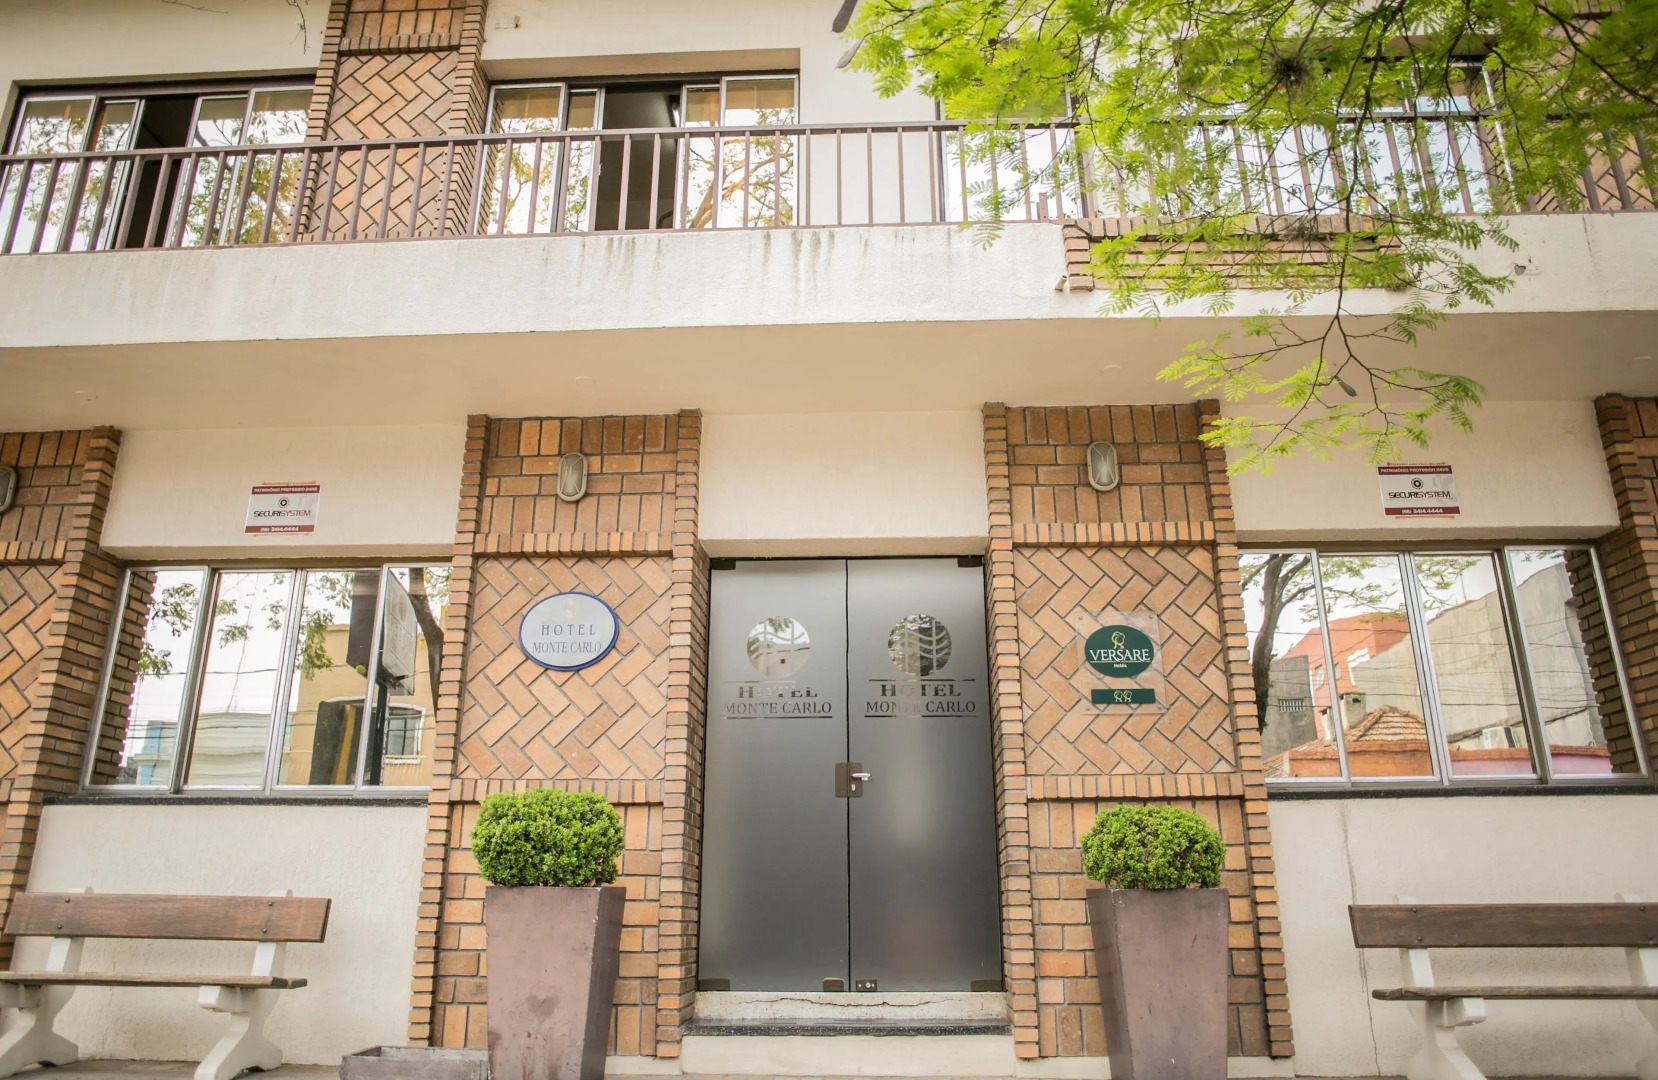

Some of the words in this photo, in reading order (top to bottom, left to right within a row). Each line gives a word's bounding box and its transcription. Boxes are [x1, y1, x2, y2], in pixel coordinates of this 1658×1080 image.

[1388, 491, 1451, 499] SECURISYSTEM
[253, 510, 311, 518] SECURISYSTEM
[541, 624, 596, 636] HOTEL
[532, 641, 568, 654] MONTE
[570, 641, 602, 653] CARLO
[1089, 649, 1151, 662] VERSARE
[725, 702, 778, 714] MONTE
[782, 701, 832, 714] CARLO
[925, 701, 976, 713] CARLO
